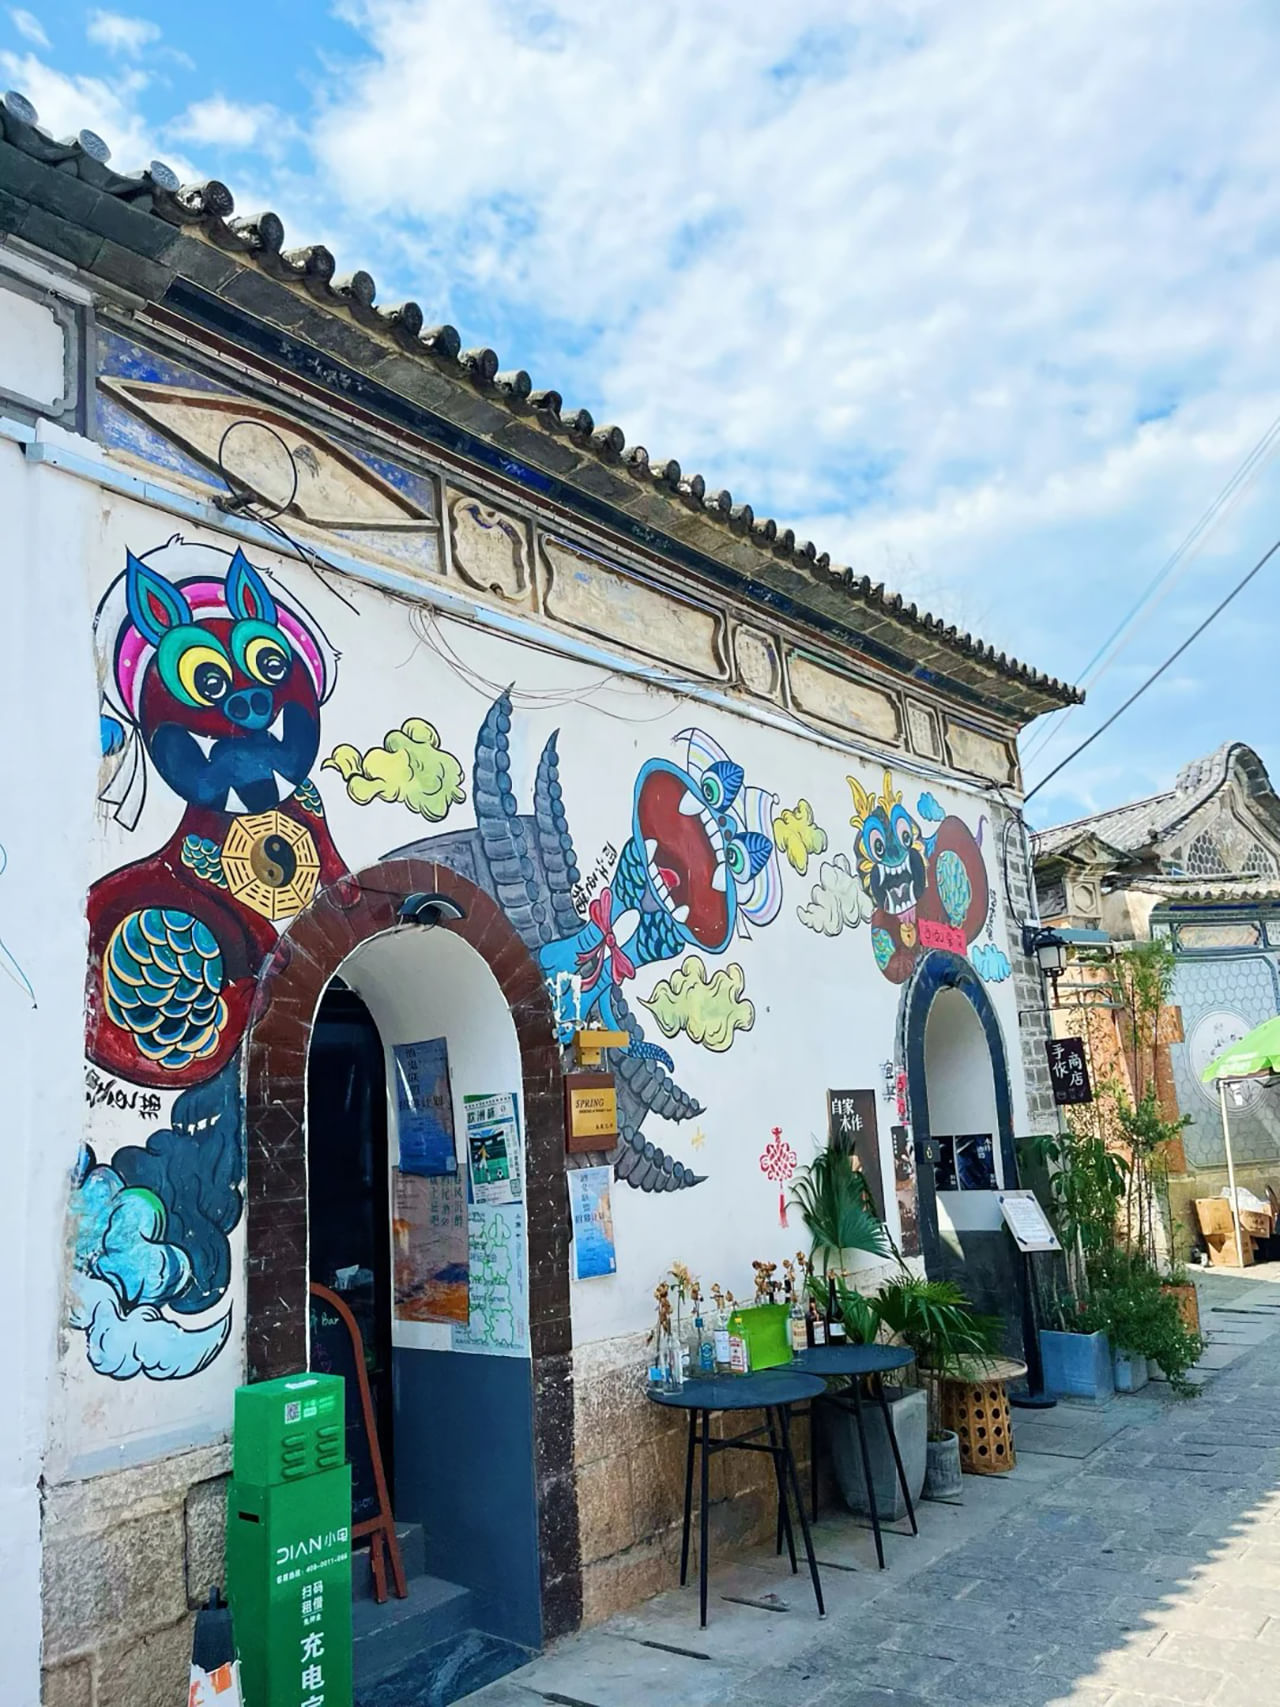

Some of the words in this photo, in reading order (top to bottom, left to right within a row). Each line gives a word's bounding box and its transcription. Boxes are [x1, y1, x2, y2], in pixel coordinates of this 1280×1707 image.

[1051, 1043, 1069, 1079] 手作
[1067, 1051, 1084, 1087] 商店
[576, 1098, 605, 1109] SPRING
[831, 1096, 855, 1115] 自家
[839, 1112, 864, 1132] 木作
[275, 1534, 323, 1565] DIAN
[301, 1579, 323, 1600] 扫码
[301, 1595, 323, 1614] 租借
